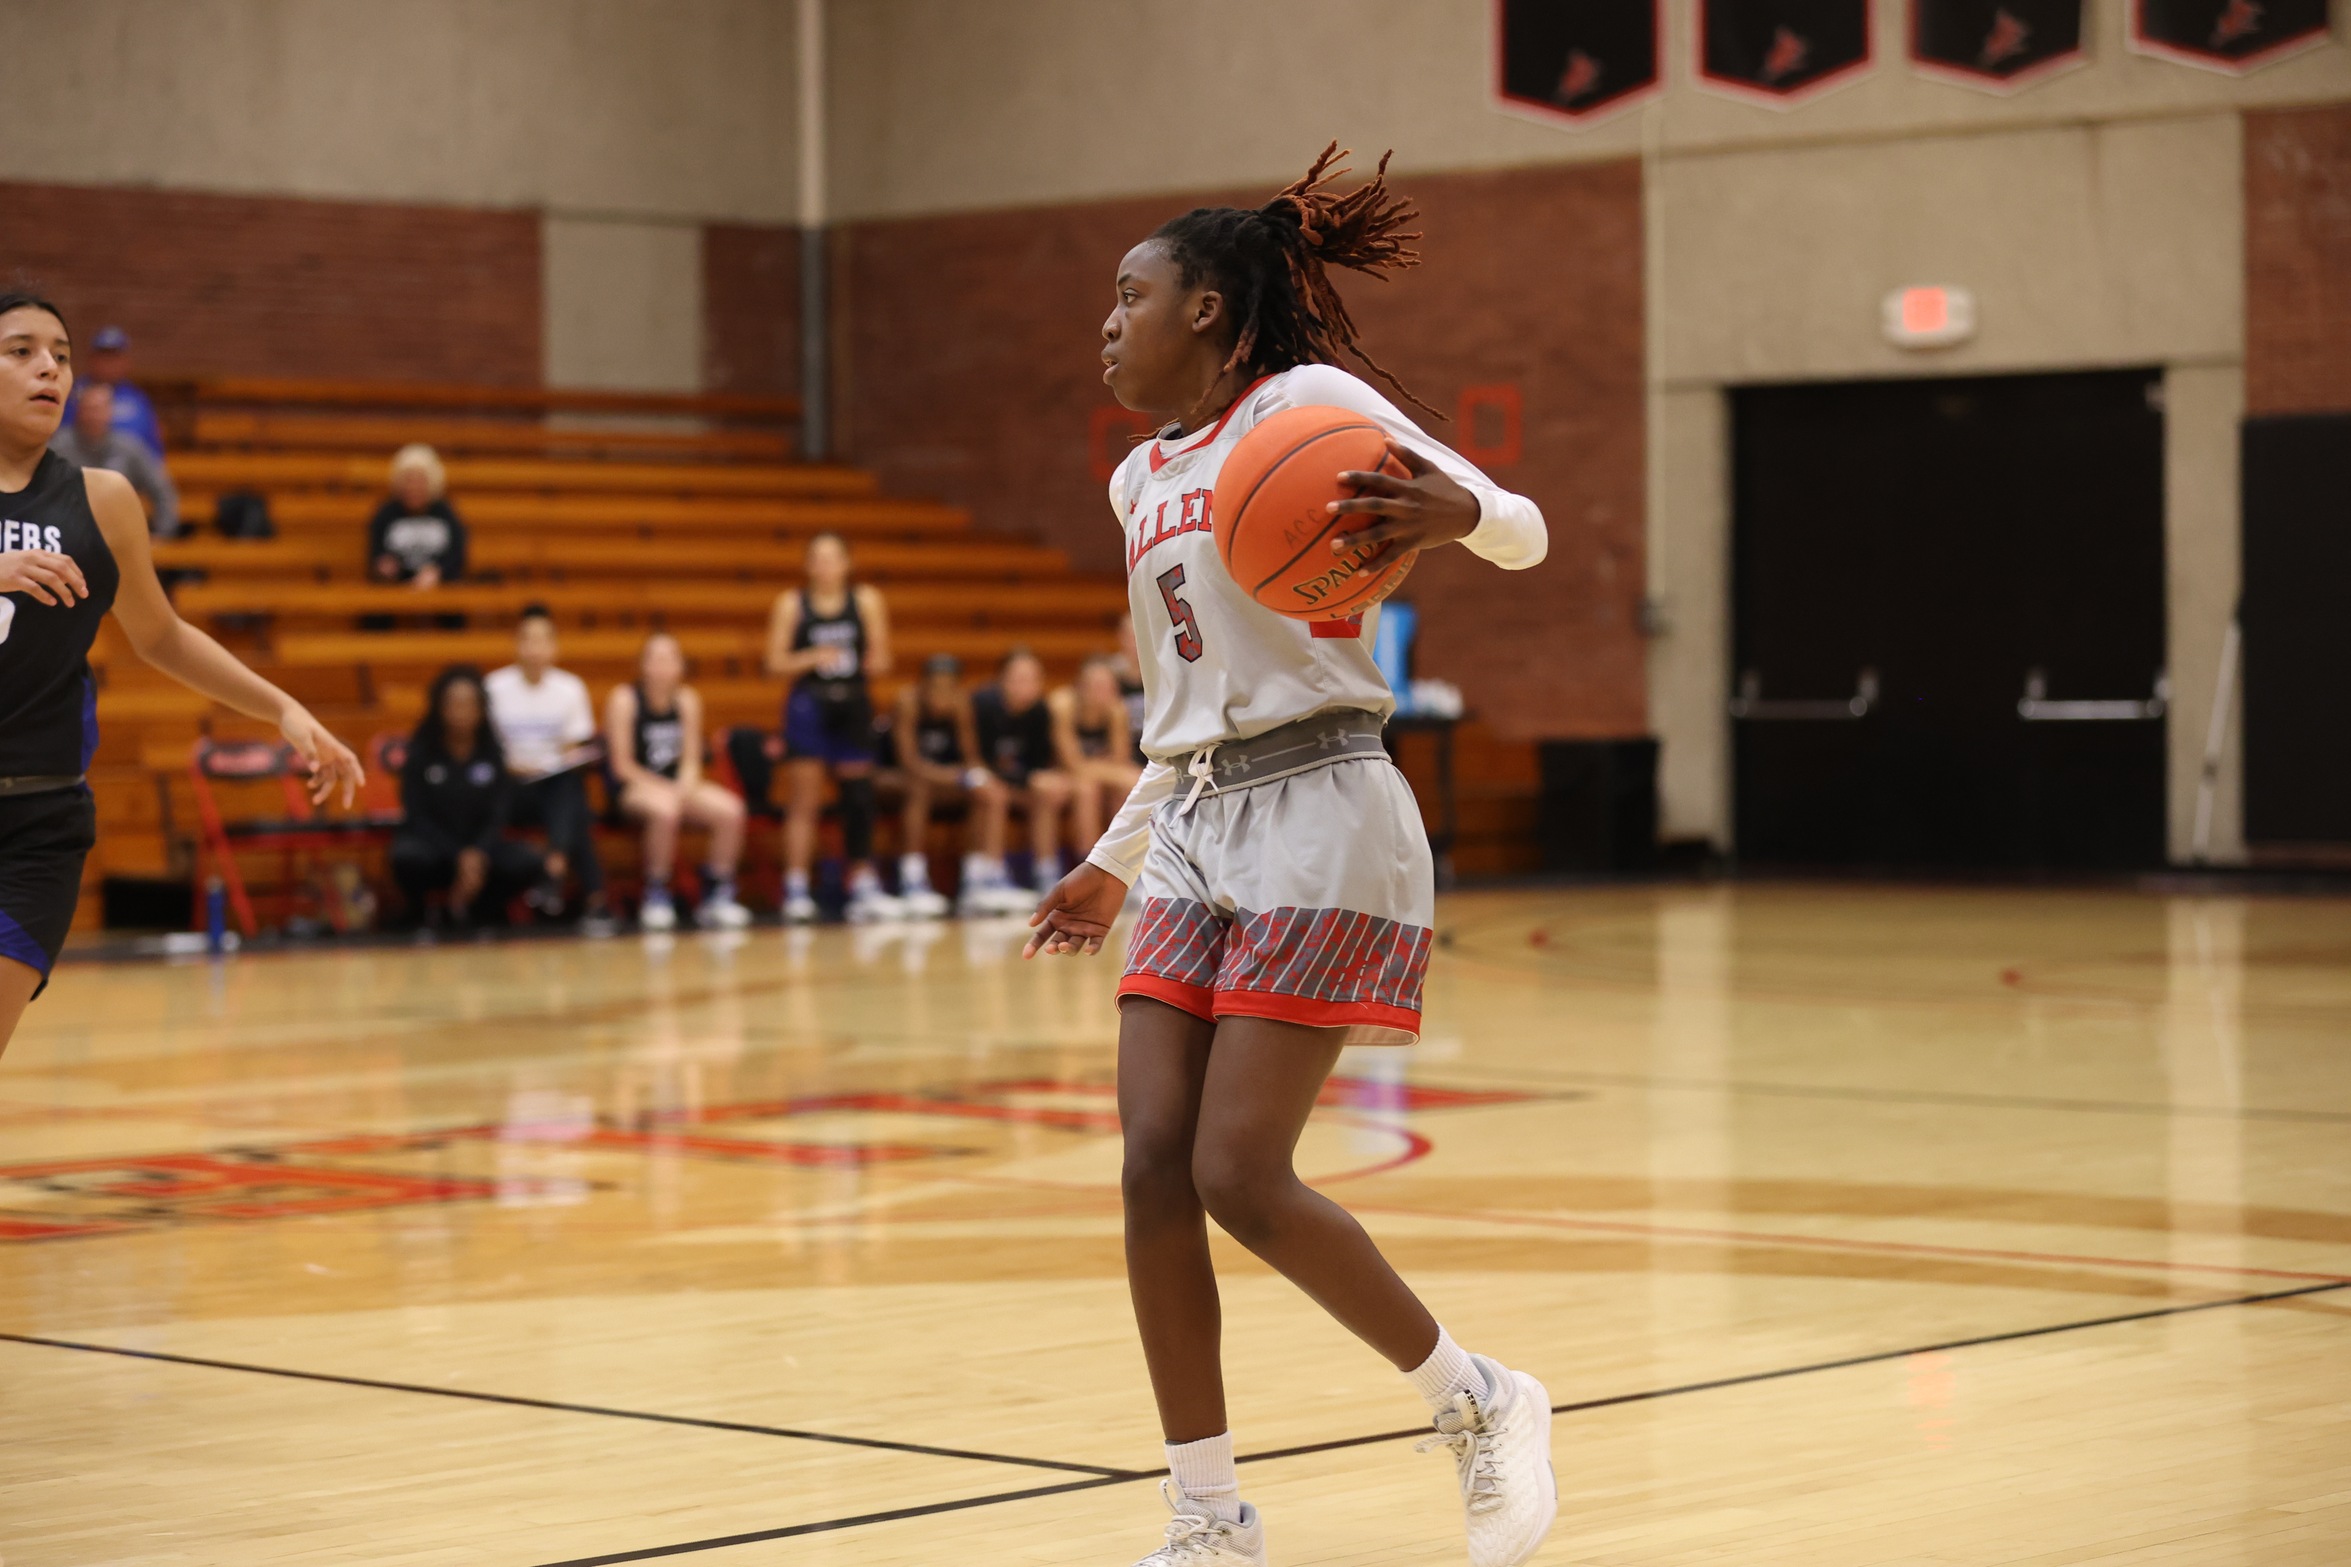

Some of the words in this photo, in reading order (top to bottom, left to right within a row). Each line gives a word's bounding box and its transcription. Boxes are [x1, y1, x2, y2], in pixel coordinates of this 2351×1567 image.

[0, 519, 62, 554] ERS
[1292, 541, 1380, 606] SPALD
[1156, 562, 1203, 663] 5
